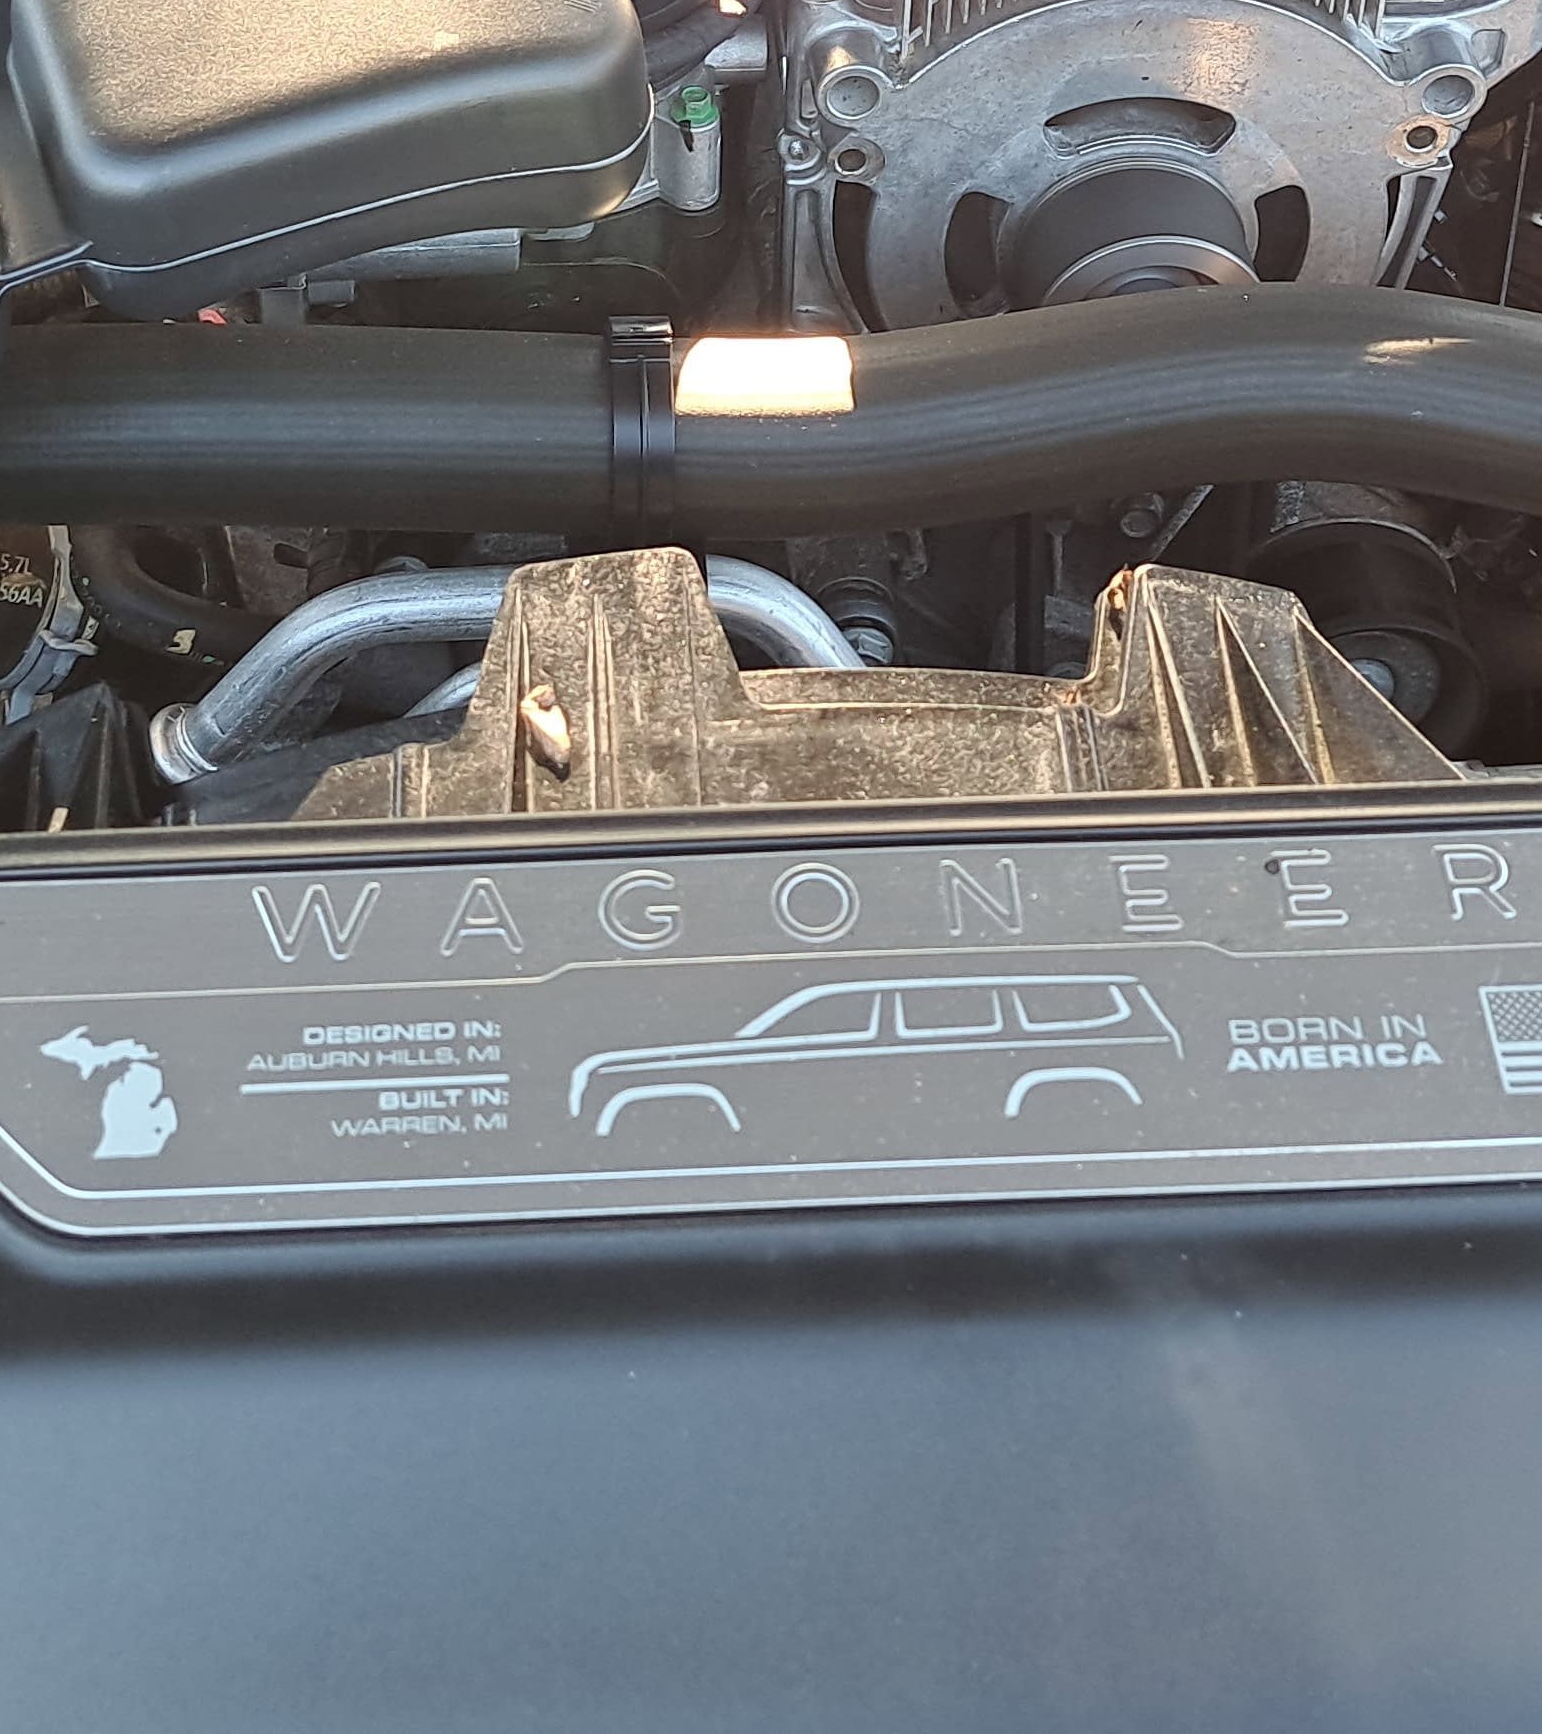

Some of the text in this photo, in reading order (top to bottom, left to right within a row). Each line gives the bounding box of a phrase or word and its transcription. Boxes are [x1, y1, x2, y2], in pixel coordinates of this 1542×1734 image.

[250, 842, 1517, 963] WAGONEER
[302, 1019, 502, 1045] DESIGNED IN:
[1227, 1013, 1427, 1043] BORN IN
[246, 1044, 502, 1073] AUBURN HILLS, MI
[1226, 1039, 1442, 1073] AMERICA
[378, 1087, 510, 1111] BUILT IN:
[331, 1111, 508, 1137] WARREN, MI
